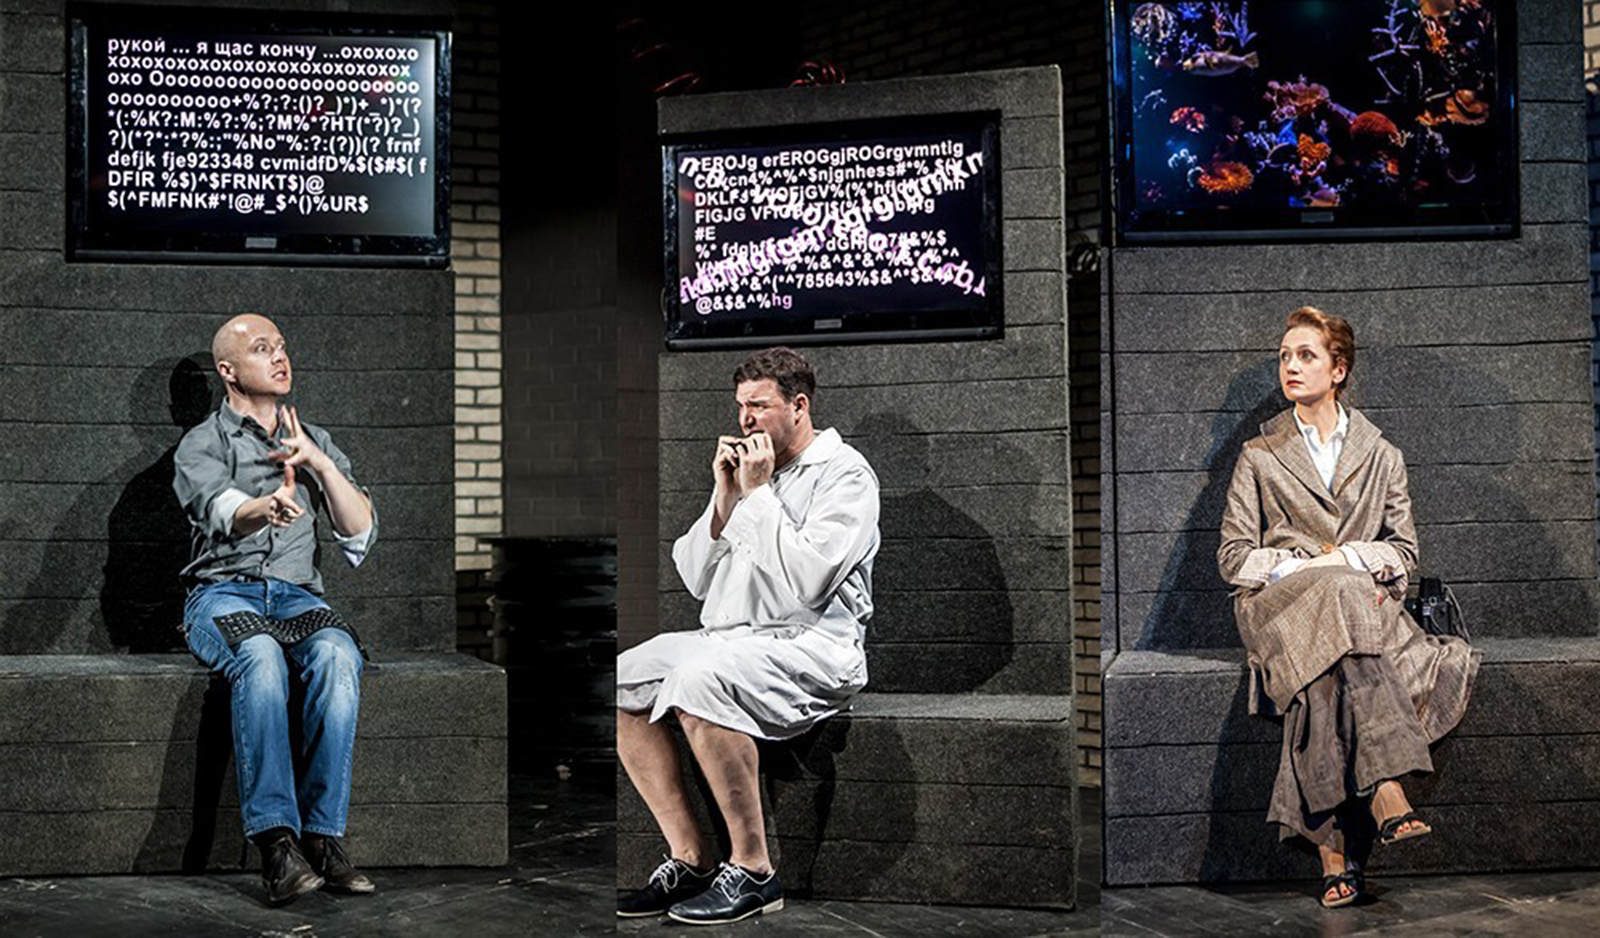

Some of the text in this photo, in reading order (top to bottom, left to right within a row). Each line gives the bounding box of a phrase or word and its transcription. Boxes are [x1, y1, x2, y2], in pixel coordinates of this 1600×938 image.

[108, 38, 166, 55] рукой
[196, 41, 208, 54] я
[215, 43, 254, 58] щас
[260, 44, 317, 61] кончу
[386, 137, 421, 153] frnf
[108, 150, 156, 170] defjk
[162, 151, 254, 172] fje923348
[419, 157, 427, 173] f
[108, 170, 325, 195] DFIR %$)^$FRNKT$)@
[695, 207, 746, 224] FIGJG
[695, 226, 716, 241] #E
